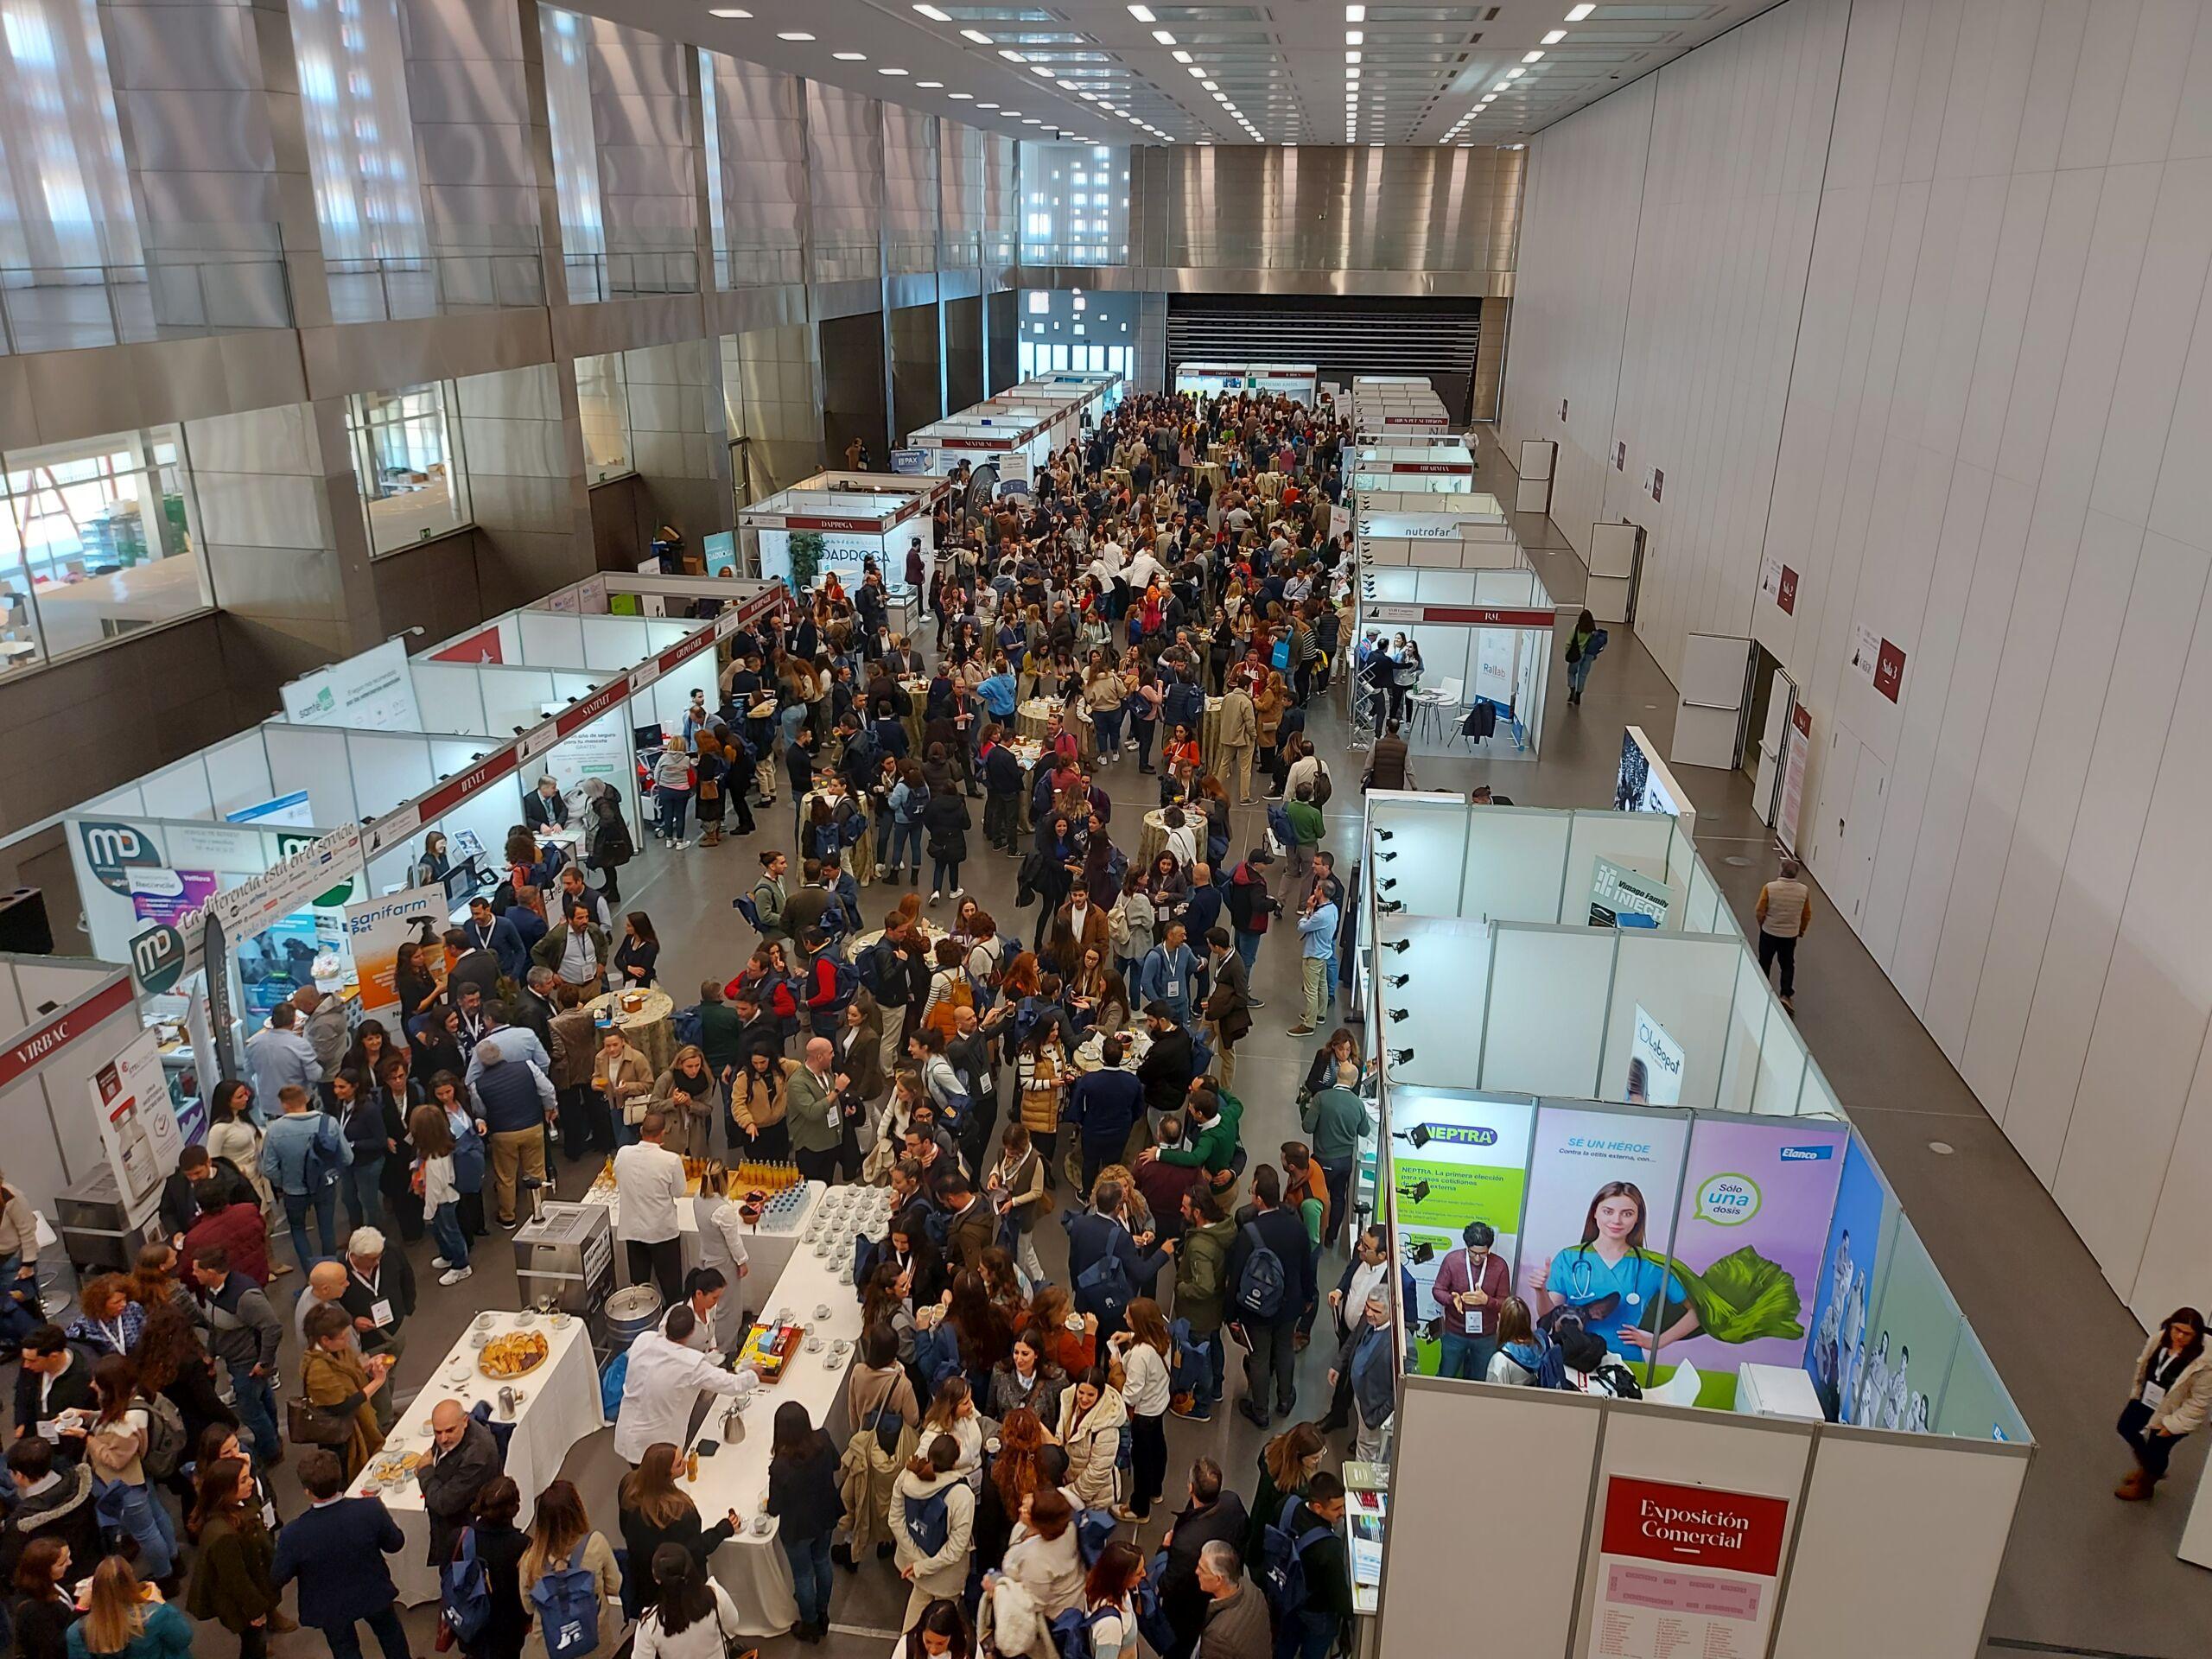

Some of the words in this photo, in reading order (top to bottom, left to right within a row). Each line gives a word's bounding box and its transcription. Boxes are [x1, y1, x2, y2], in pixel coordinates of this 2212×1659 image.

[821, 520, 853, 529] DAPROGA
[1406, 527, 1451, 537] nutrofar
[182, 912, 200, 930] La
[205, 875, 261, 915] diferencia
[318, 823, 354, 853] servicio
[1618, 880, 1645, 897] Vimago
[1645, 893, 1669, 908] Family
[351, 899, 427, 927] sanifarm
[353, 925, 372, 935] Pet
[17, 1021, 69, 1063] VIRBAC
[1587, 1140, 1605, 1149] UN
[1782, 1148, 1817, 1160] Elanco
[1440, 1178, 1477, 1186] cotidianos
[1446, 1171, 1472, 1179] primera
[1474, 1173, 1503, 1182] elección
[1719, 1183, 1743, 1193] Sólo
[1708, 1192, 1749, 1206] una
[1713, 1205, 1741, 1215] dosis
[1641, 1499, 1749, 1530] Exposición
[1642, 1520, 1743, 1549] Comercial
